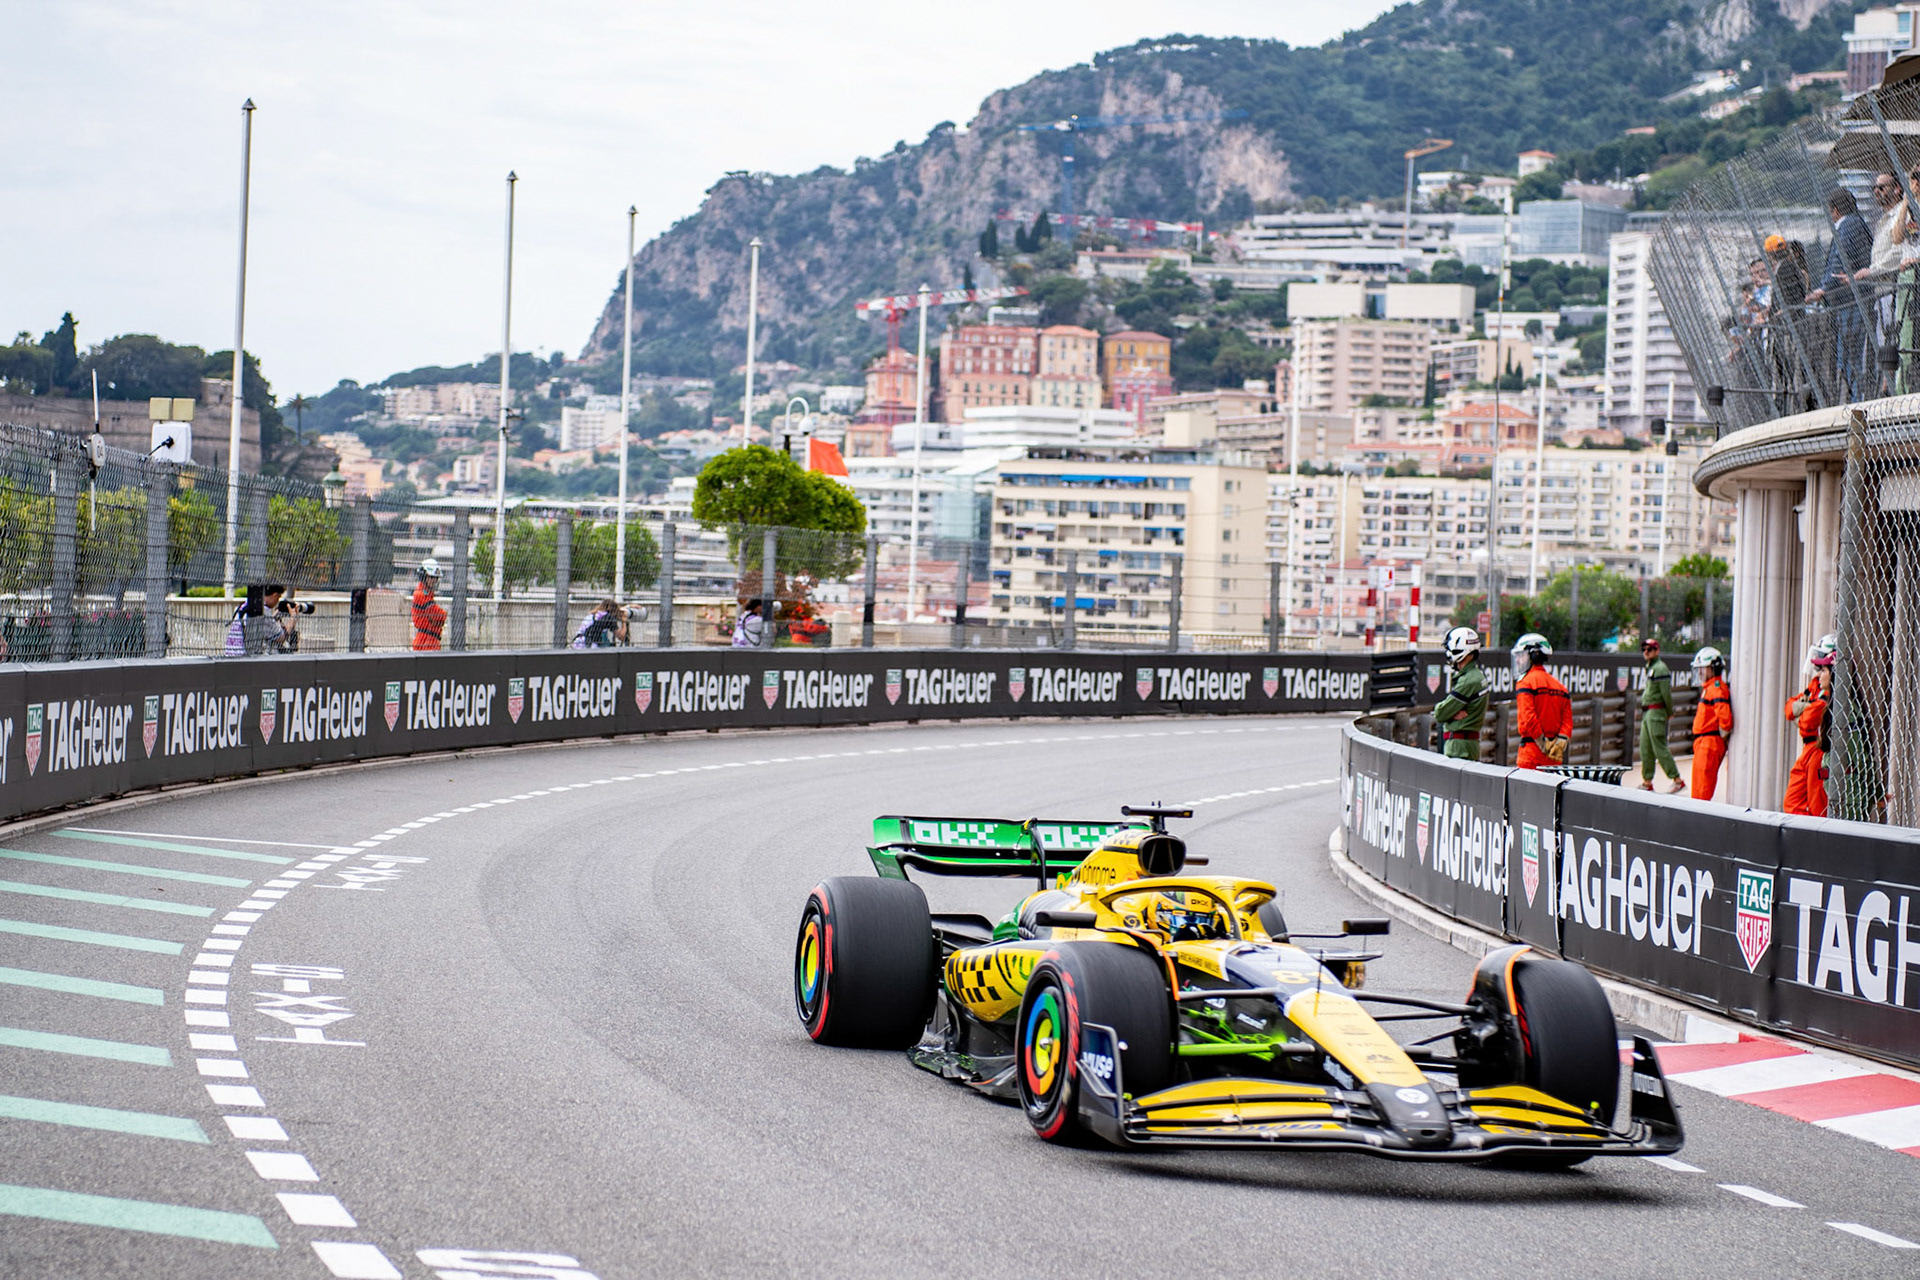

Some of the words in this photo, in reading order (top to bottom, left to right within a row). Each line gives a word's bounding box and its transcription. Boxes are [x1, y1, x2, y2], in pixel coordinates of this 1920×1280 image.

[387, 686, 399, 700] TAG
[510, 682, 523, 695] TAG
[529, 675, 622, 721] TAGHeuer
[657, 671, 750, 712] TAGHeuer
[784, 670, 873, 708] TAGHeuer
[906, 669, 996, 704] TAGHeuer
[1030, 668, 1122, 702] TAGHeuer
[1158, 668, 1251, 700] TAGHeuer
[1283, 668, 1368, 699] TAGHeuer
[145, 701, 157, 719] TAG
[263, 693, 275, 710] TAG
[281, 687, 372, 743] TAGHeuer
[405, 680, 496, 729] TAGHeuer
[28, 709, 41, 731] TAG
[47, 700, 132, 772] TAGHeuer
[163, 692, 248, 755] TAGHeuer
[913, 821, 996, 847] OKX
[1036, 823, 1119, 849] OKX
[1524, 828, 1537, 857] TAG
[1543, 828, 1715, 956] TAGHeuer
[1741, 877, 1770, 911] TAG
[1738, 915, 1769, 964] HEUER
[1271, 970, 1335, 985] 81
